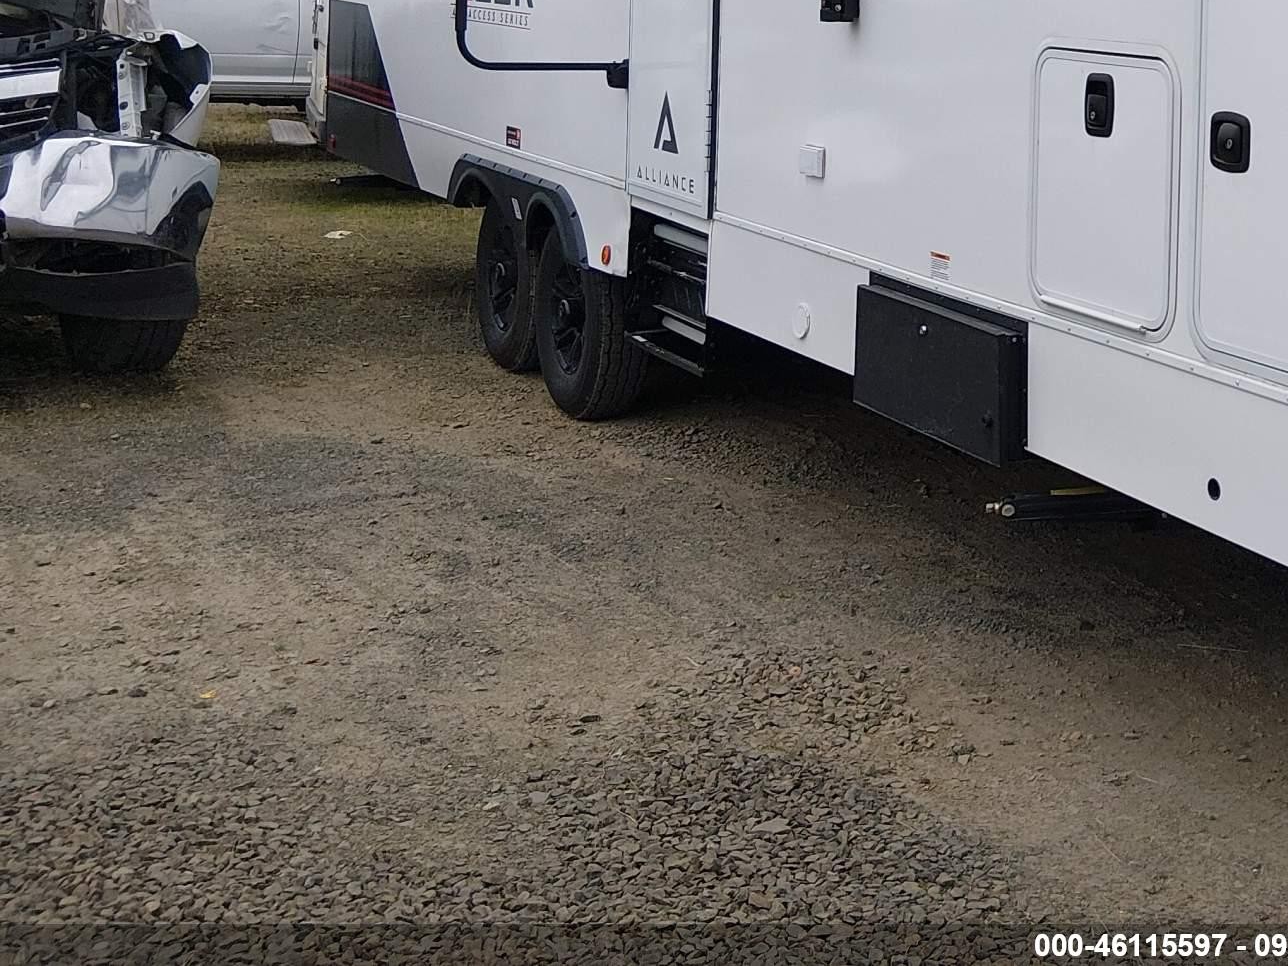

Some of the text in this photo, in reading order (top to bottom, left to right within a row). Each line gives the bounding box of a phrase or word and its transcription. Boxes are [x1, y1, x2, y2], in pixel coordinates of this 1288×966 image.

[468, 9, 496, 22] ACCESS
[500, 13, 529, 27] SERIES
[637, 165, 695, 194] ALLIANCE
